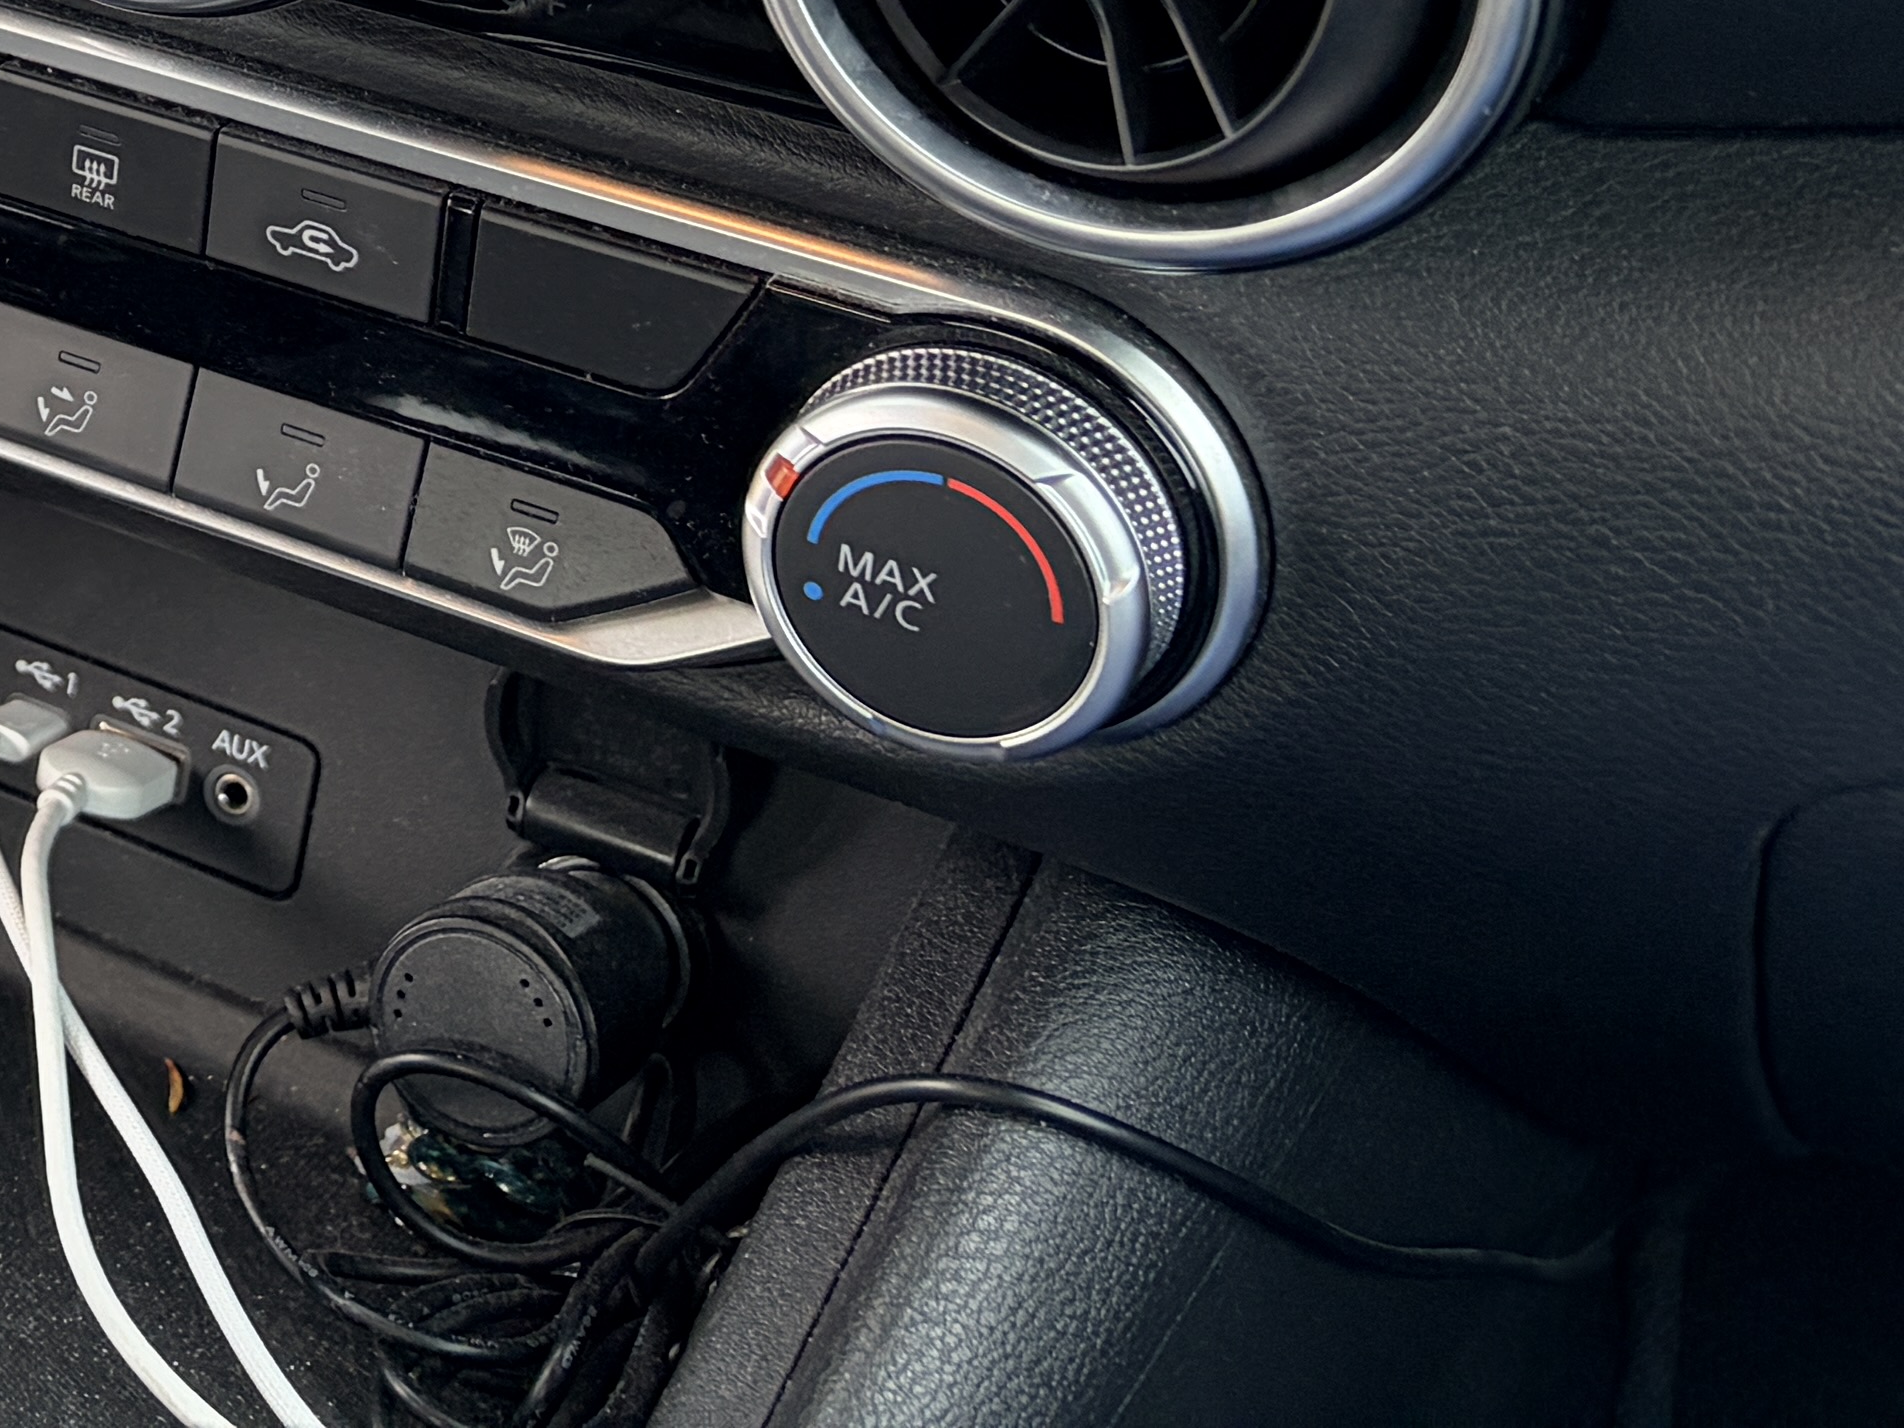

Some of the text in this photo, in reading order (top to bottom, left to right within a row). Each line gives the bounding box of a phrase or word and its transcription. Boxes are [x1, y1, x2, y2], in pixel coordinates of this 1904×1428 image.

[70, 183, 117, 211] REAR
[837, 543, 938, 604] MAX
[839, 587, 922, 633] A/C
[66, 671, 79, 697] 1
[162, 709, 185, 736] 2
[211, 729, 269, 770] AUX
